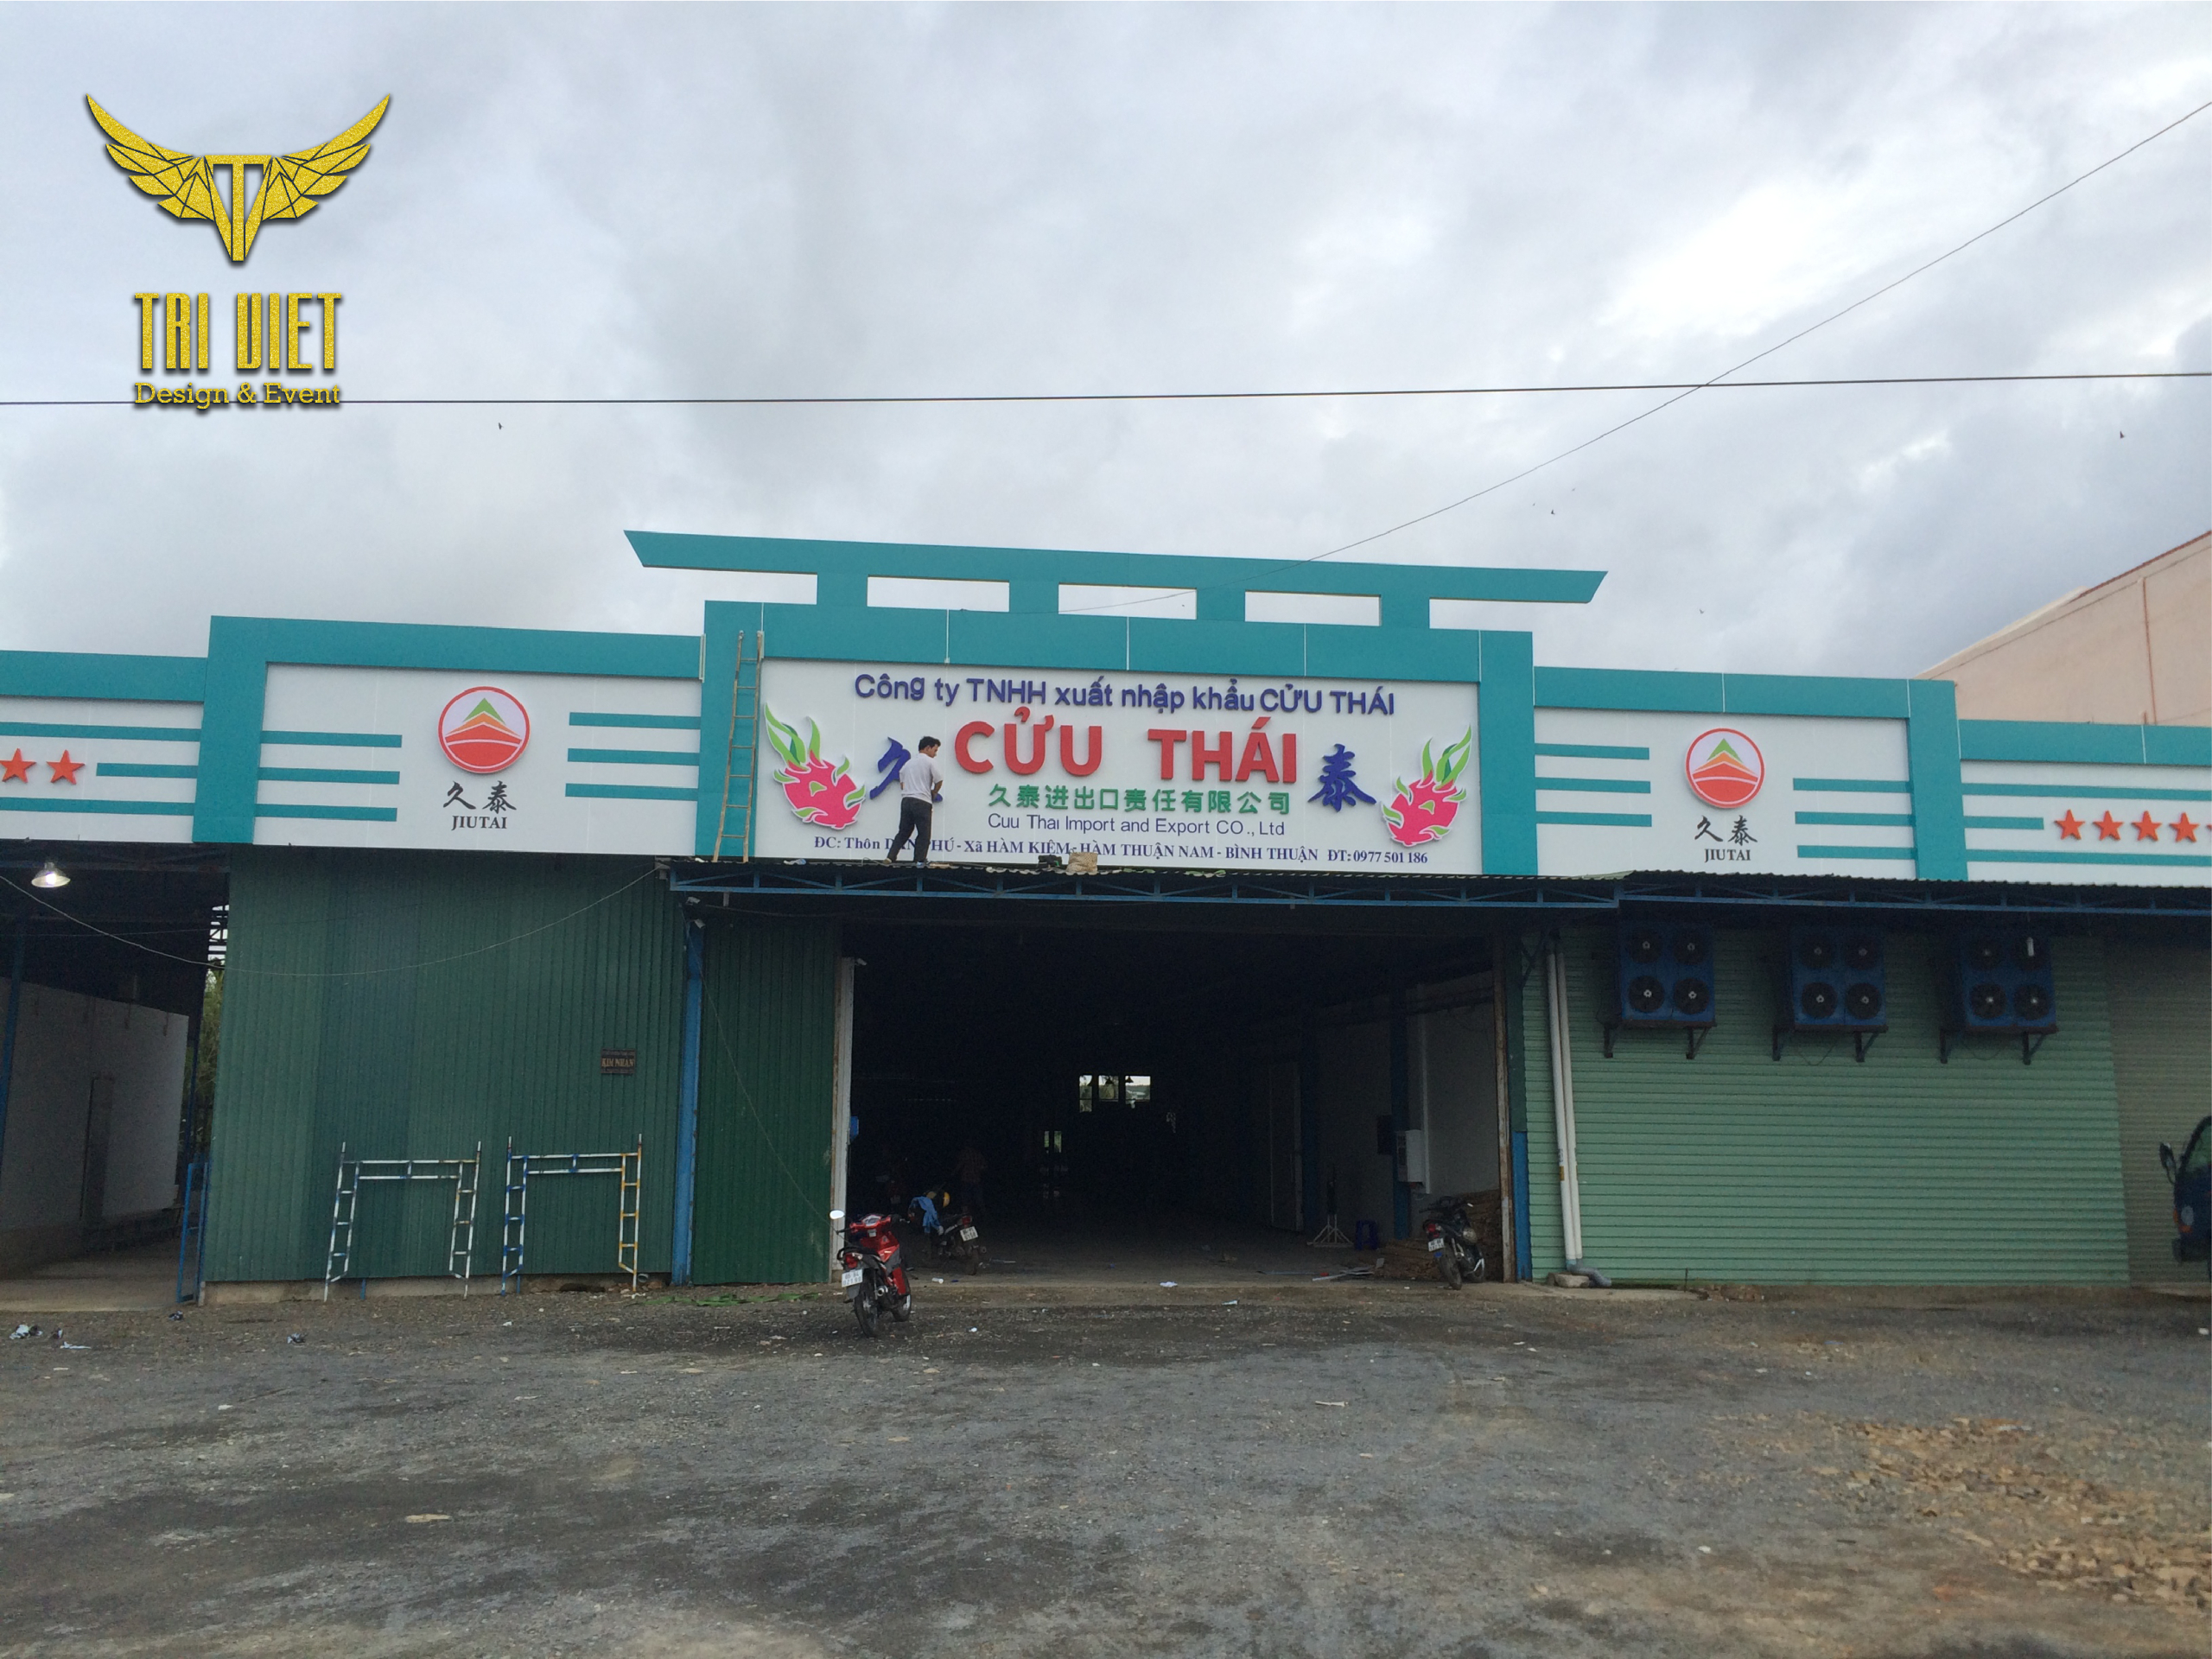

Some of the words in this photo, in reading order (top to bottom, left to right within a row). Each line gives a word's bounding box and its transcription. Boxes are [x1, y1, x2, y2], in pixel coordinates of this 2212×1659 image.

[855, 674, 925, 701] Công
[934, 677, 960, 707] ty
[967, 677, 1046, 704] TNHH
[1055, 676, 1113, 707] xuất
[1121, 683, 1185, 714] nhập
[1192, 678, 1254, 710] khẩu
[1260, 683, 1323, 712] CỬU
[1330, 686, 1395, 715] THÁI
[955, 706, 1103, 776] CỬU
[1147, 716, 1297, 783] THÁI
[1307, 743, 1377, 811] 泰
[442, 780, 517, 814] 久泰
[988, 783, 1290, 815] 久泰进出口责任有限公司
[451, 815, 508, 831] JIUTAI
[988, 813, 1020, 829] Cuu
[1065, 816, 1116, 834] Import
[1121, 817, 1149, 832] and
[1155, 817, 1211, 836] Export
[1259, 821, 1285, 836] Ltd
[1694, 815, 1758, 846] 久泰
[814, 836, 842, 849] ĐC:
[844, 837, 880, 849] Thôn
[963, 840, 983, 853] Xã
[987, 837, 1024, 853] HÀM
[1079, 839, 1116, 856] HÀM
[1121, 842, 1175, 860] THUẬN
[1179, 845, 1214, 859] NAM
[1225, 843, 1262, 860] BÌNH
[1267, 845, 1319, 863] THUẬN
[1384, 852, 1404, 863] 501
[1408, 852, 1428, 864] 186
[1704, 848, 1751, 863] JIUTAI
